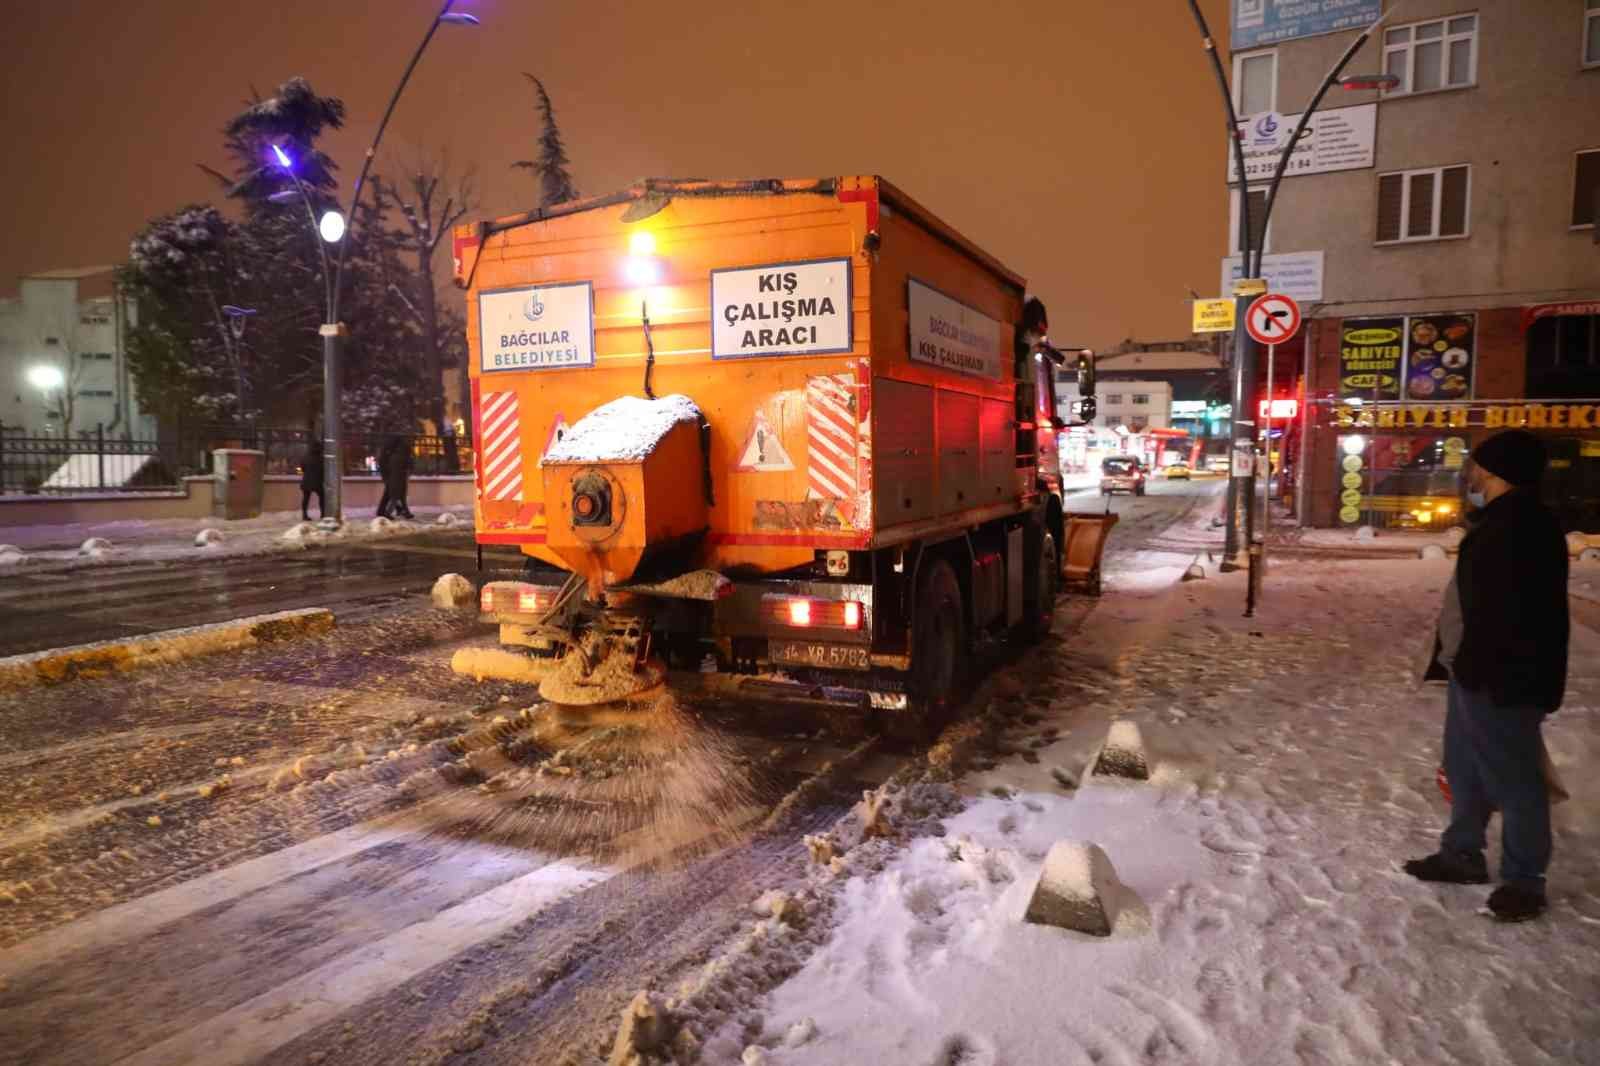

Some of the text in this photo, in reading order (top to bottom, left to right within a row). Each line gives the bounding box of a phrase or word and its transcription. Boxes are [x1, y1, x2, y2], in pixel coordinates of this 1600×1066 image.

[758, 272, 797, 294] KIŞ
[724, 297, 836, 327] ÇALIŞMA
[500, 329, 570, 348] BAĞCILAR
[741, 326, 817, 348] ARACI
[1335, 405, 1469, 428] SARIYER
